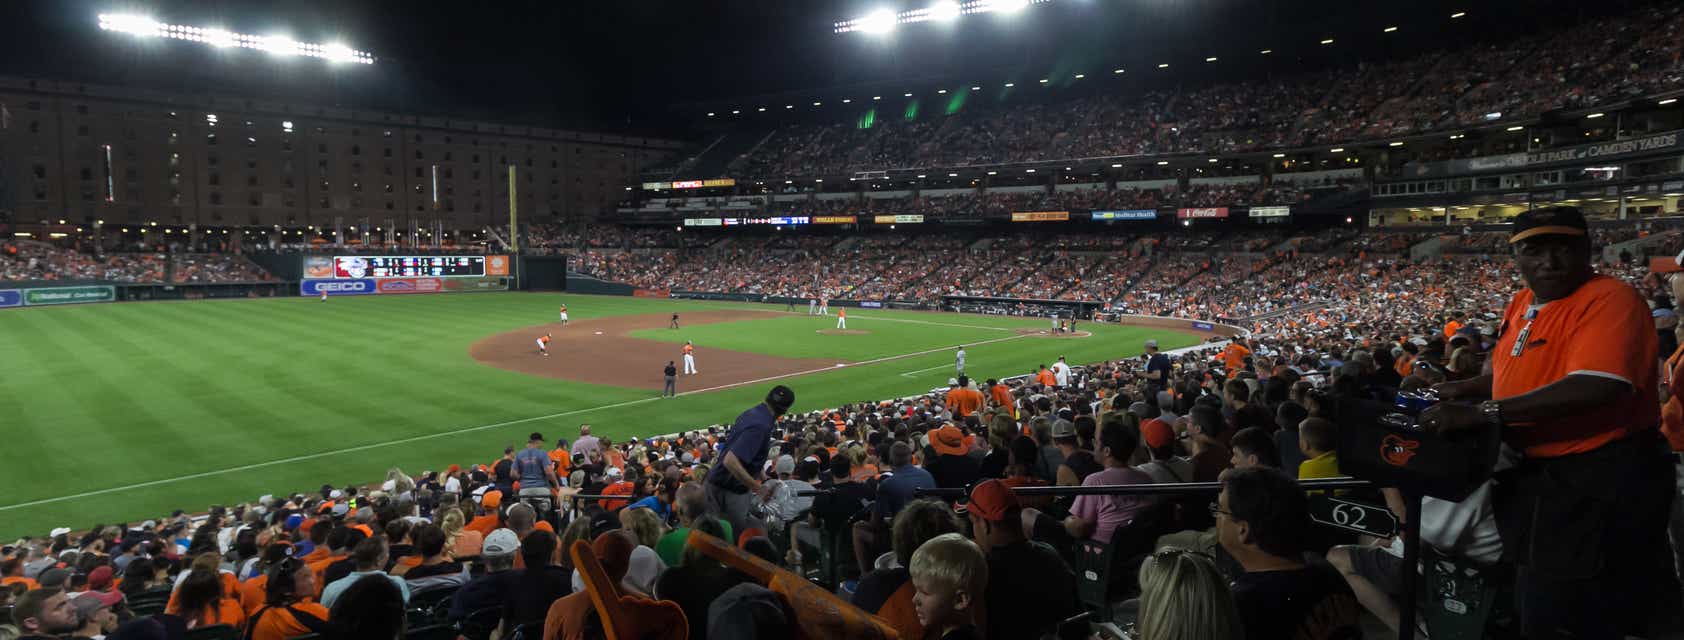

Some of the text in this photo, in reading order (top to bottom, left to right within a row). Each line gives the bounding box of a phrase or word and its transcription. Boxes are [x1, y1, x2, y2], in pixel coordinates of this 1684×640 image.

[1548, 149, 1577, 161] PARK
[1588, 140, 1638, 156] CAMDEN
[1638, 134, 1676, 150] YARDS
[315, 282, 366, 291] GEICO
[1333, 503, 1367, 529] 62
